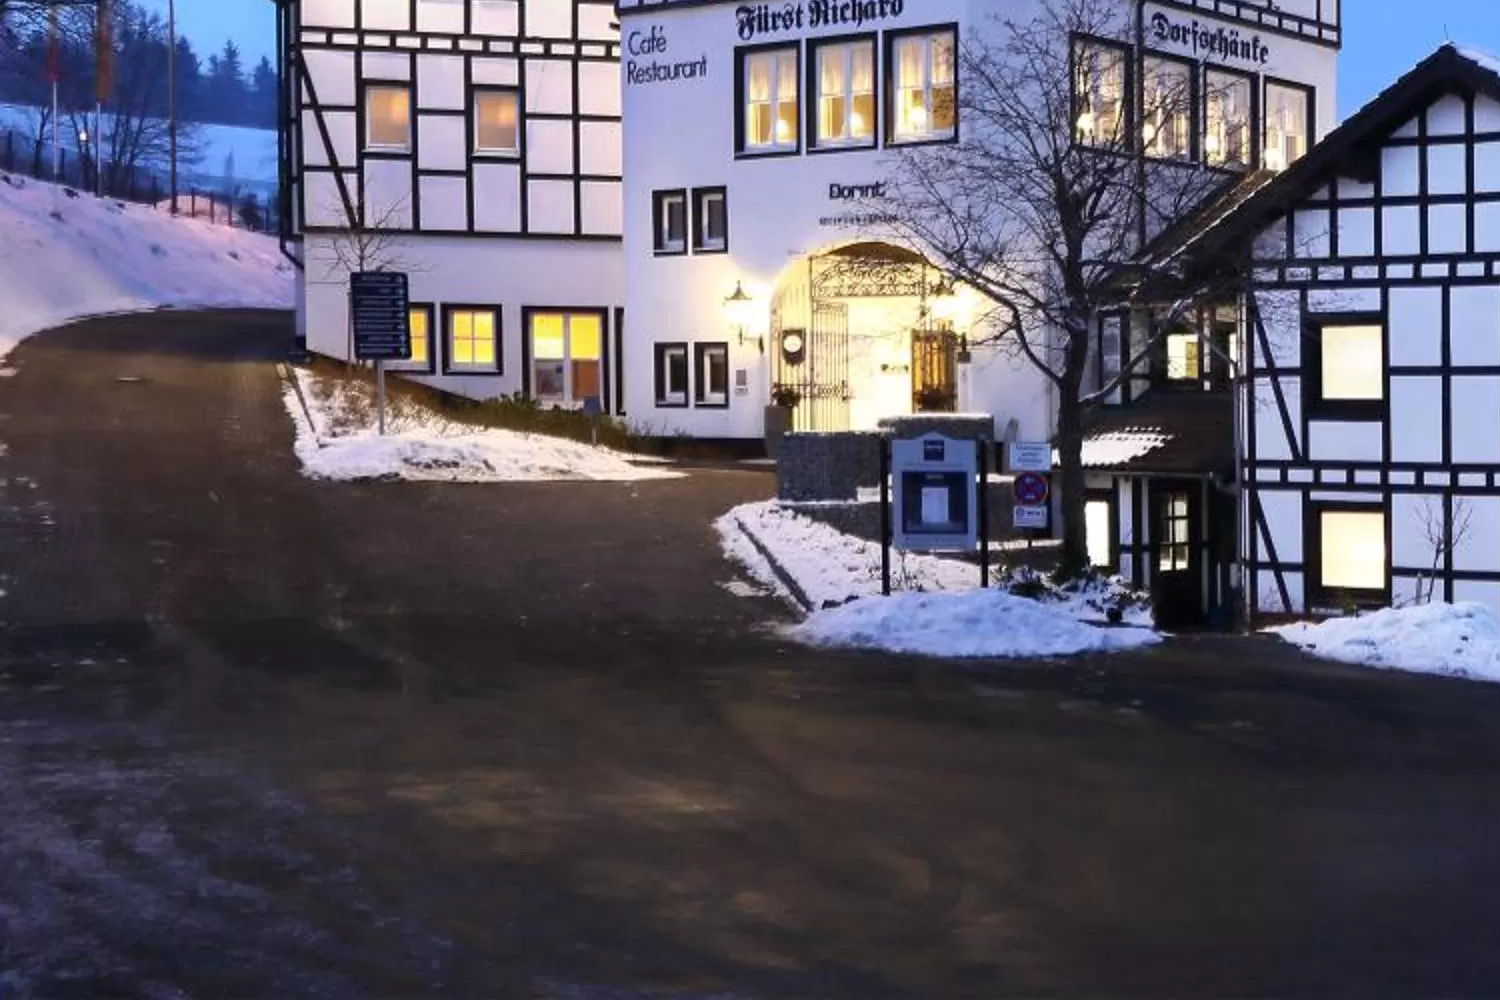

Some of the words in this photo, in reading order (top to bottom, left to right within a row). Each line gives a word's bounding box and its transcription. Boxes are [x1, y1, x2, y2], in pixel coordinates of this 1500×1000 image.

[735, 2, 804, 40] Fürst
[1151, 11, 1269, 64] Dorfschänke
[627, 25, 667, 56] Café
[627, 55, 707, 85] Restaurant
